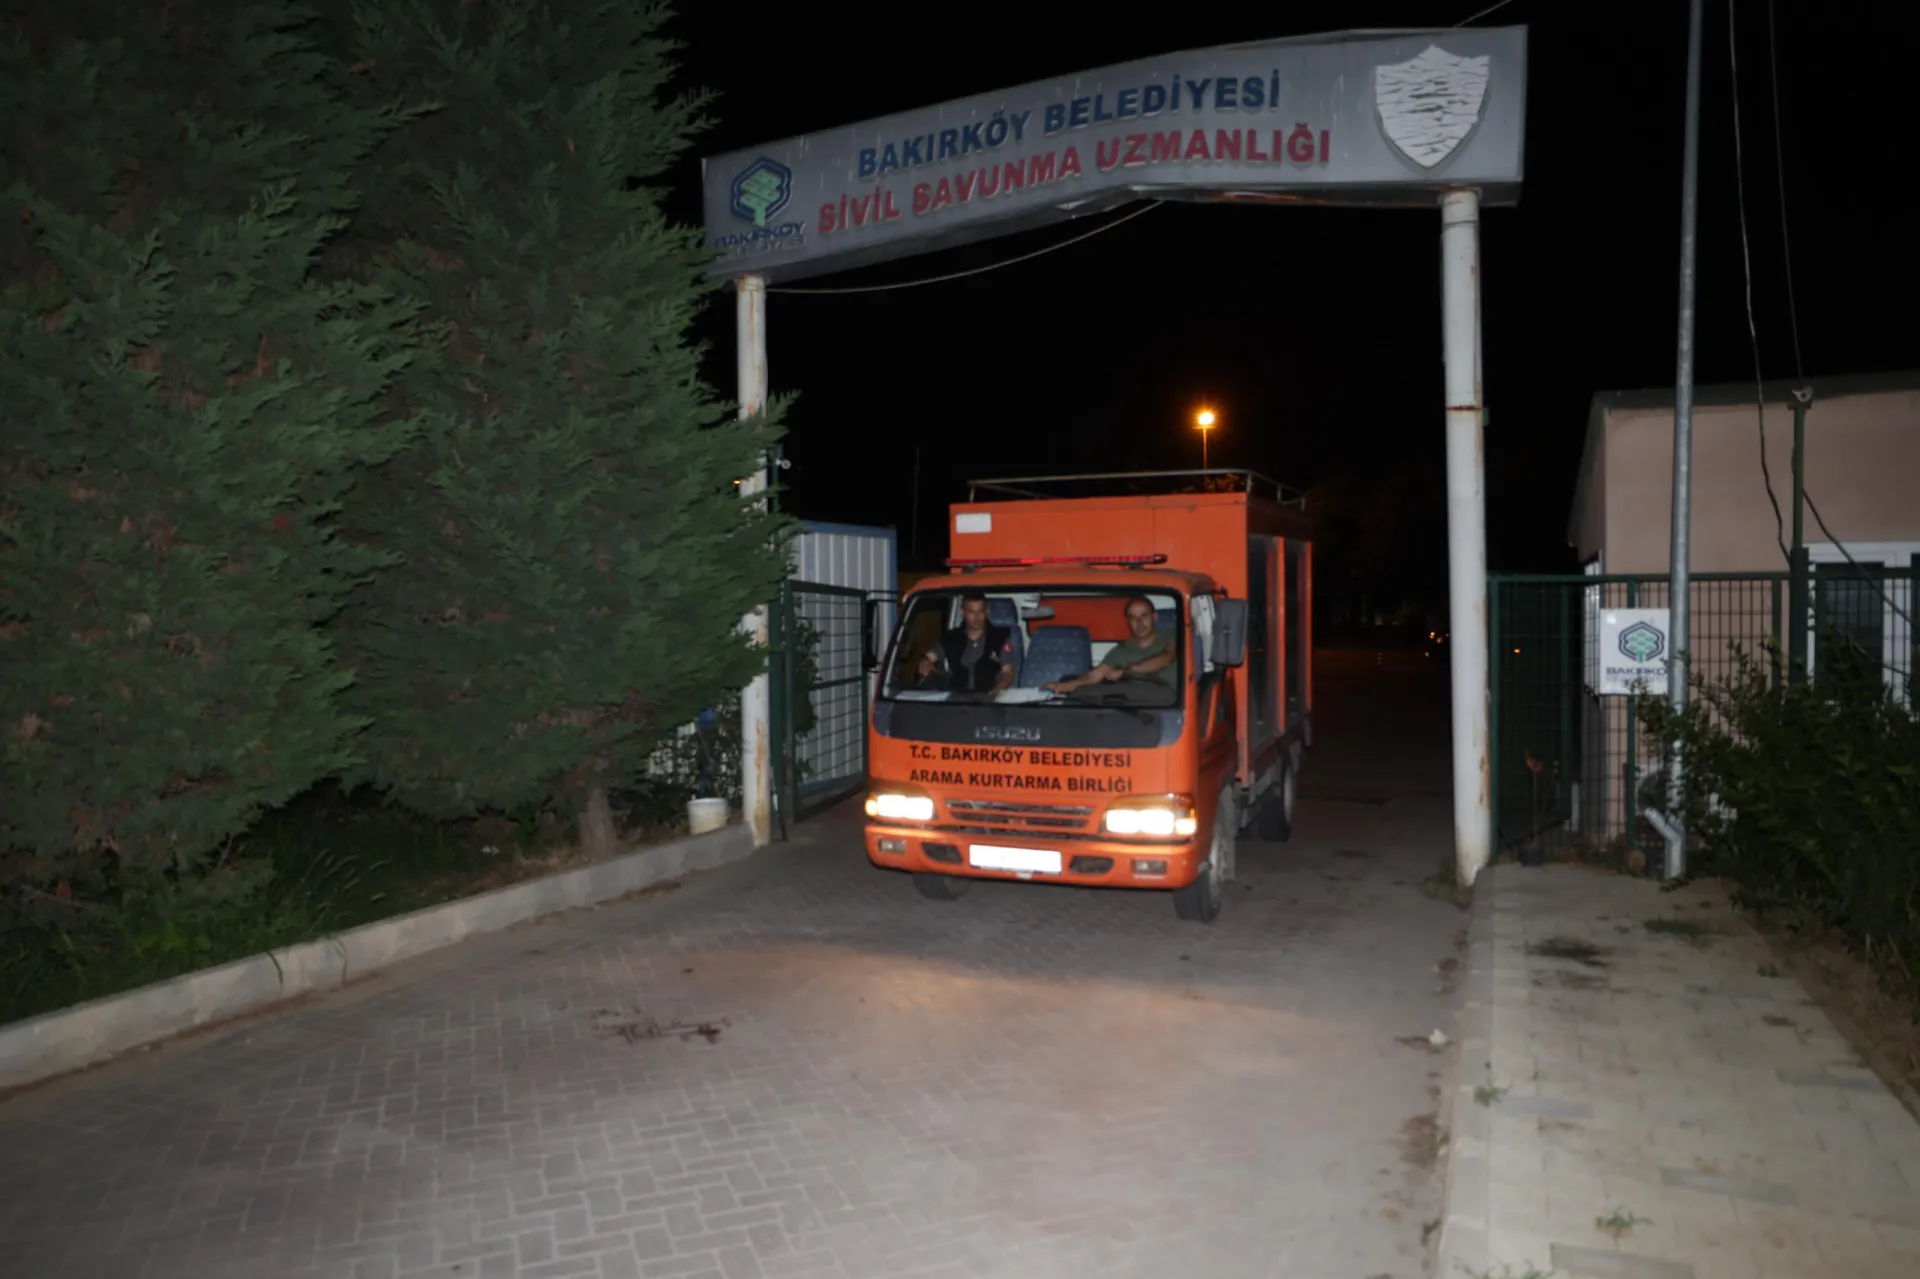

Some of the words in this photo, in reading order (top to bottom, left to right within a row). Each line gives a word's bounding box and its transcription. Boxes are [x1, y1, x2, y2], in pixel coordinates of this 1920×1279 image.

[858, 108, 1032, 179] BAKIRKÖY
[1043, 69, 1280, 136] BELEDİYESİ
[818, 184, 902, 234] SİVİL
[911, 147, 1082, 216] SAVUNMA
[1096, 122, 1330, 170] UZMANLIĞI
[974, 726, 1041, 740] ISUZU
[909, 745, 937, 760] T.C.
[941, 746, 1024, 763] BAKIRKÖY
[1029, 750, 1131, 767] BELEDİYESİ
[909, 769, 963, 785] ARAMA
[968, 773, 1062, 791] KURTARMA
[1067, 775, 1132, 793] BİRLİĞİ
